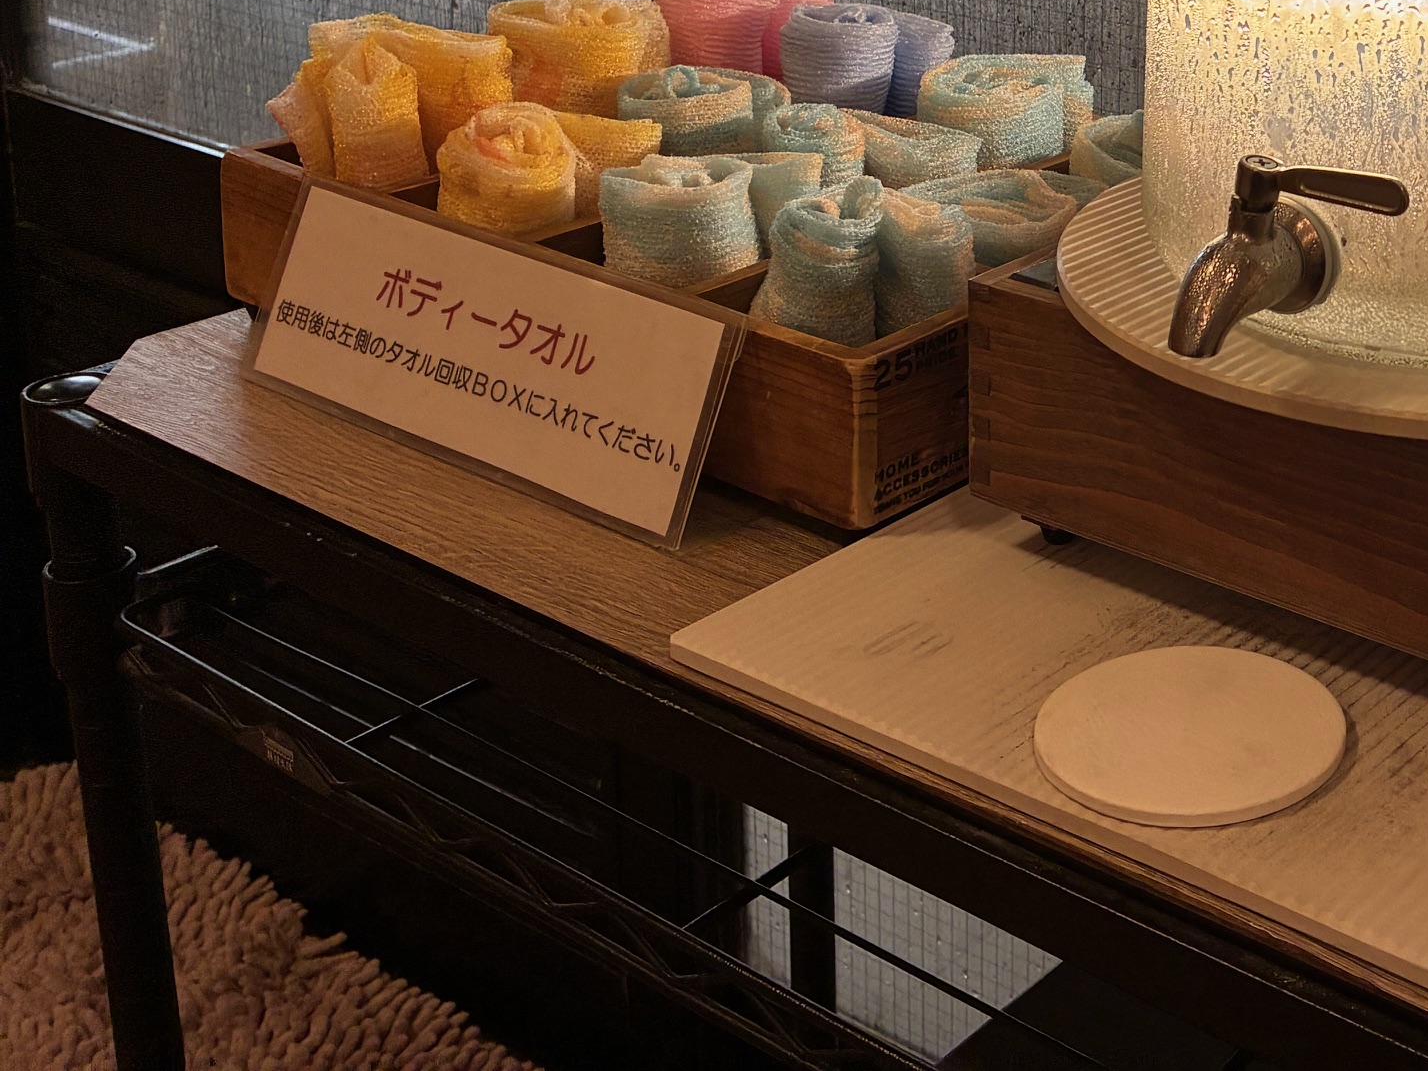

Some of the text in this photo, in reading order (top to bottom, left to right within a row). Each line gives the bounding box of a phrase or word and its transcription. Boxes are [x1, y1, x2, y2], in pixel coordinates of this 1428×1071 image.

[375, 267, 596, 376] ボディータオル
[874, 348, 912, 392] 25
[874, 451, 921, 485] HOME
